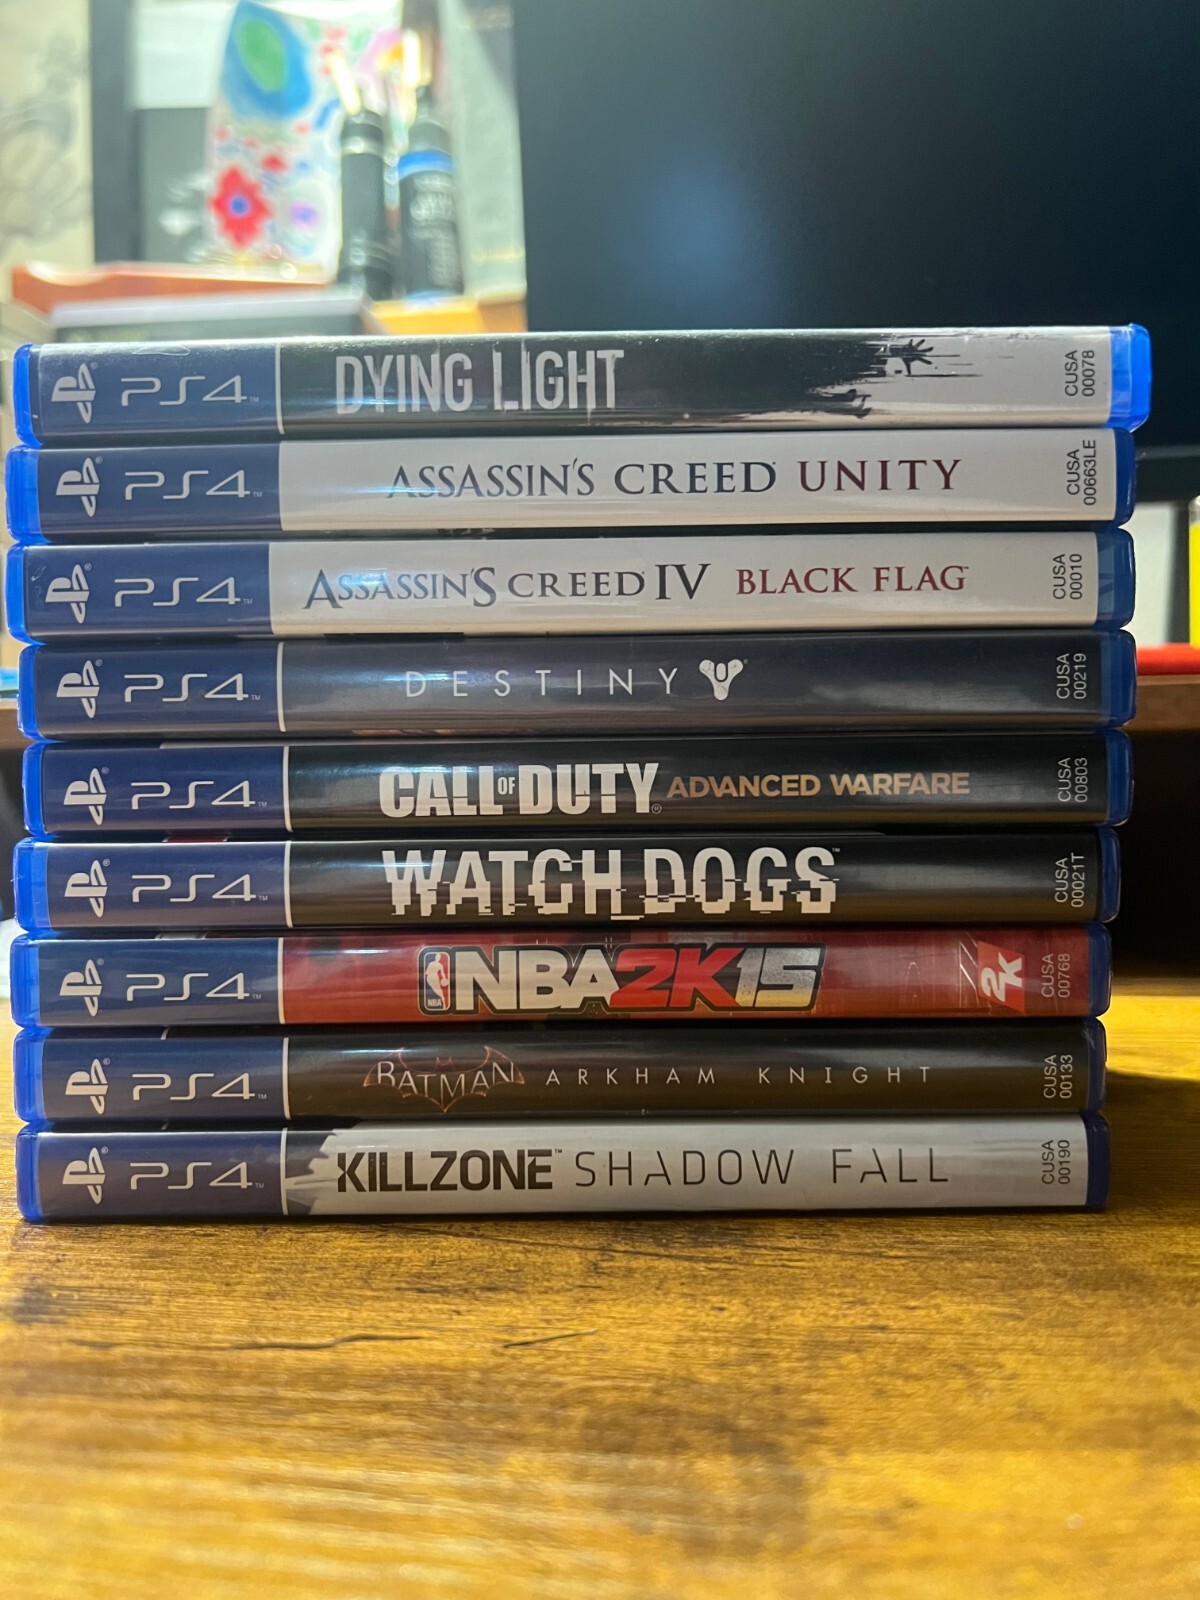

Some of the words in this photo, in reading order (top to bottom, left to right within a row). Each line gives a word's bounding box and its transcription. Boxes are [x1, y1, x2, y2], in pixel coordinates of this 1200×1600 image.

[121, 375, 248, 407] PS4
[336, 352, 473, 415] DYING
[492, 345, 625, 414] LIGHT
[1064, 350, 1078, 397] CUSA
[1082, 350, 1095, 397] 00078
[125, 469, 251, 500] PS4
[387, 457, 595, 499] ASSASSIN'S
[614, 461, 777, 495] CREED
[797, 459, 962, 492] UNITY
[1067, 449, 1080, 495] CUSA
[1083, 439, 1097, 506] 00663LE
[115, 576, 242, 608] PS4
[303, 567, 497, 609] ASSASSIN'S
[508, 571, 645, 598] CREED
[655, 563, 712, 601] IV
[736, 567, 858, 596] BLACK
[873, 565, 969, 592] FLAG
[1052, 553, 1066, 600] CUSA
[1069, 553, 1083, 600] 00010
[124, 673, 250, 702] PS4
[405, 667, 679, 698] DESTINY
[1056, 653, 1070, 700] CUSA
[1073, 653, 1087, 700] 00219
[131, 780, 256, 810] PS4
[379, 765, 504, 818] CALL
[497, 776, 516, 796] OF
[518, 762, 660, 815] DUTY
[666, 773, 822, 799] ADVANCED
[829, 772, 971, 795] WARFARE
[1057, 757, 1072, 802] CUSA
[1074, 757, 1088, 803] 00803
[131, 874, 257, 903] PS4
[1055, 857, 1069, 903] CUSA
[1071, 852, 1085, 908] 00021T
[126, 972, 251, 1002] PS4
[980, 951, 1023, 1003] 2K
[1041, 953, 1055, 998] CUSA
[1058, 953, 1071, 998] 00768
[427, 998, 442, 1008] NBA
[132, 1072, 256, 1101] PS4
[376, 1060, 515, 1100] BATMAN
[545, 1068, 716, 1086] ARKHAM
[757, 1066, 931, 1084] KNIGHT
[1043, 1054, 1057, 1099] CUSA
[1060, 1054, 1073, 1099] 00133
[130, 1161, 254, 1190] PS4
[337, 1149, 554, 1193] KILLZONE
[575, 1149, 795, 1187] SHADOW
[831, 1147, 949, 1184] FALL
[1041, 1140, 1055, 1185] CUSA
[1058, 1140, 1071, 1185] 00190
